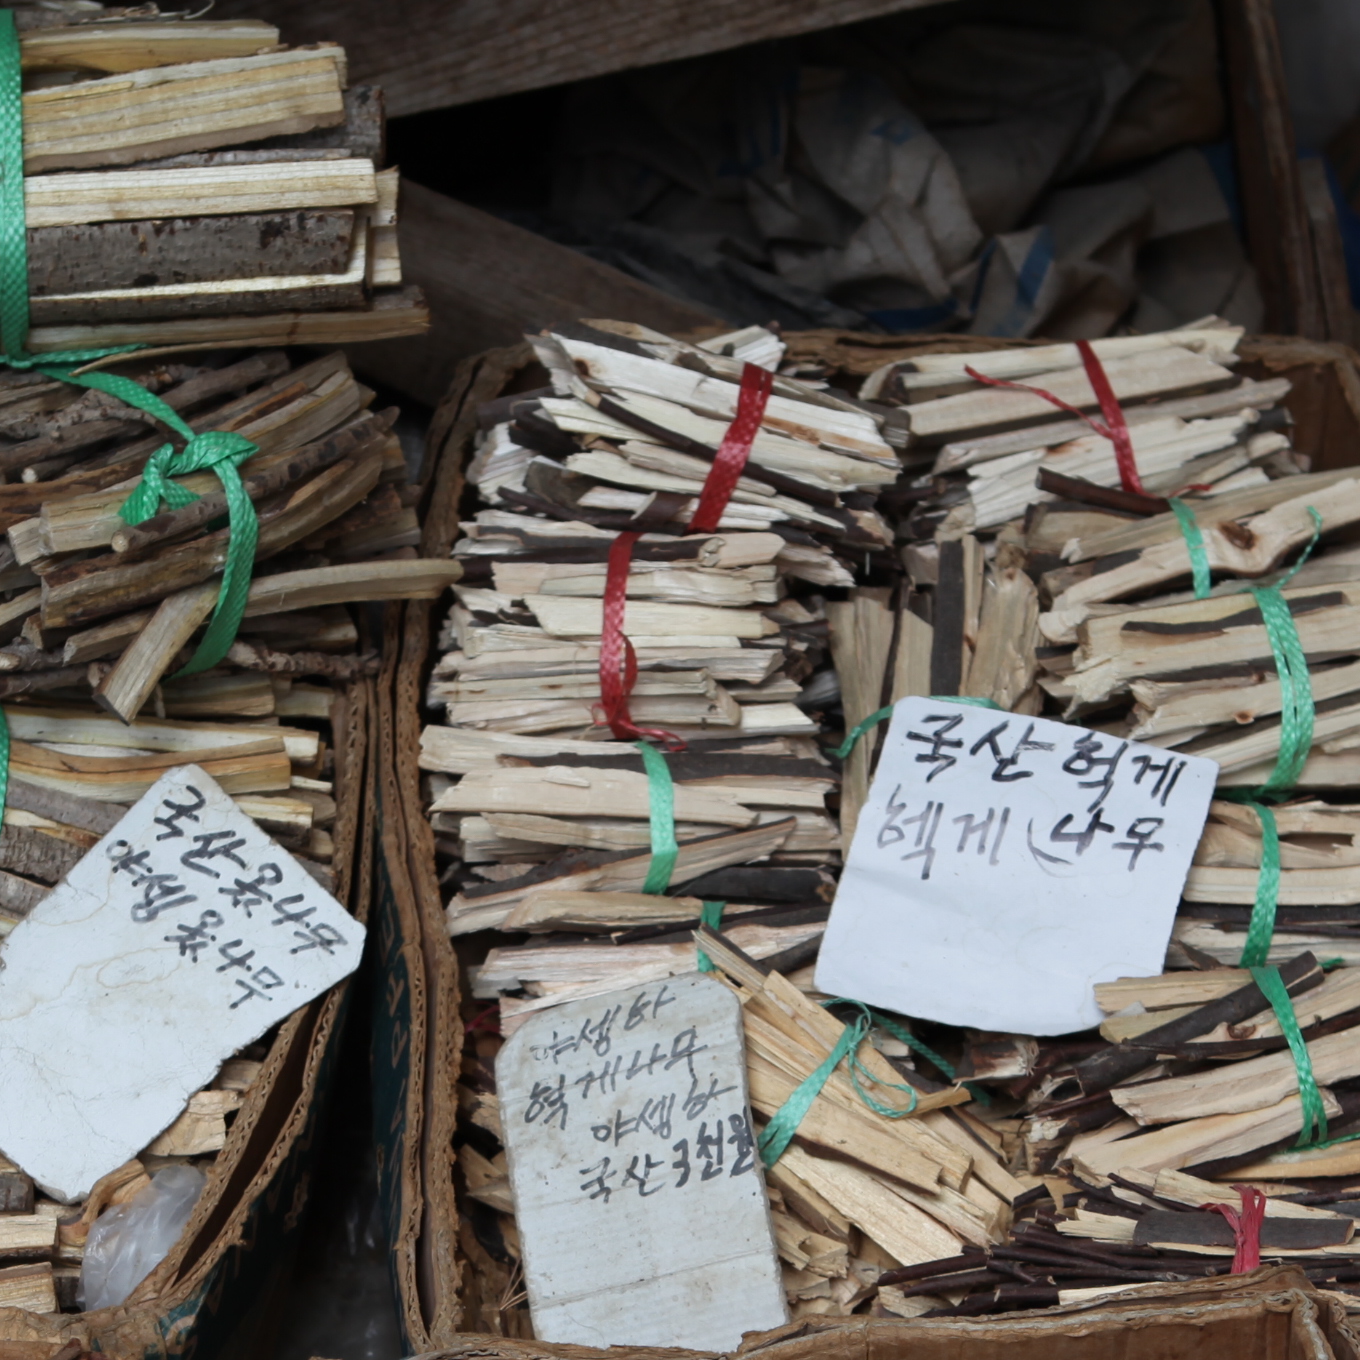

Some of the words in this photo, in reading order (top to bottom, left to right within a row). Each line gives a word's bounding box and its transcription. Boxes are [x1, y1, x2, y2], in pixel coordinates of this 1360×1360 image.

[905, 713, 1056, 783] 국산
[154, 785, 247, 879] 국산
[579, 1153, 665, 1204] 국산
